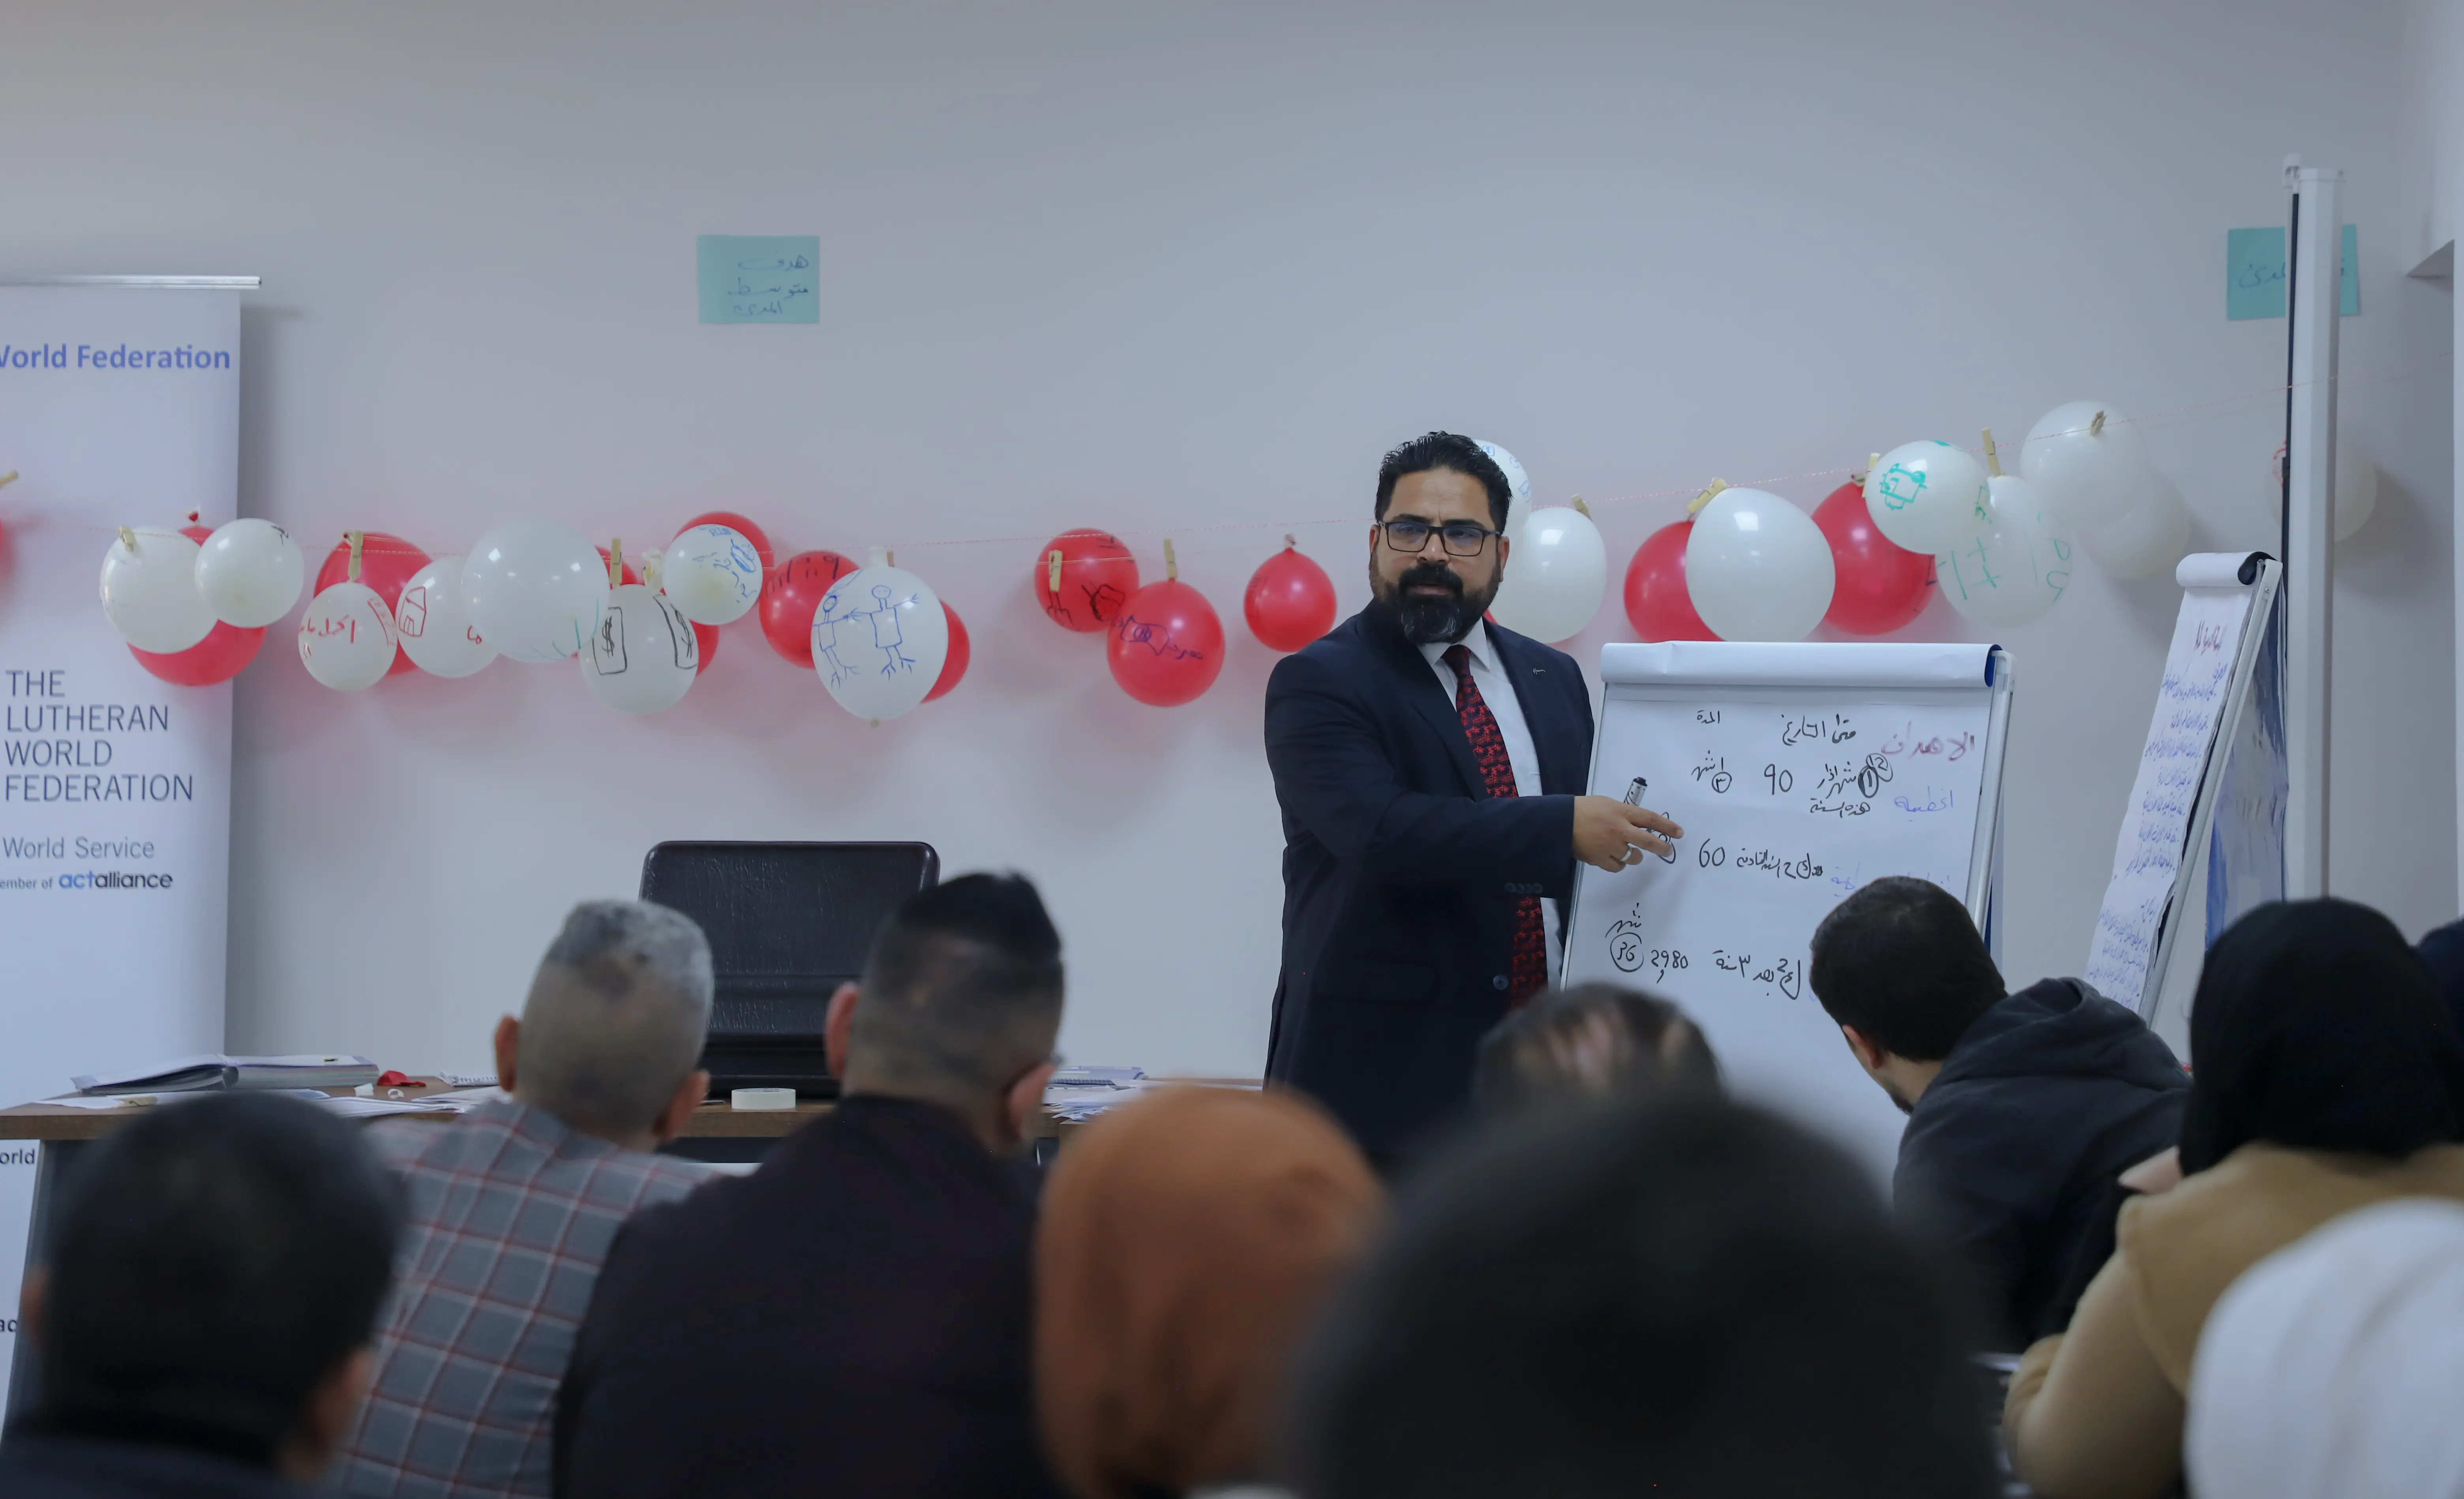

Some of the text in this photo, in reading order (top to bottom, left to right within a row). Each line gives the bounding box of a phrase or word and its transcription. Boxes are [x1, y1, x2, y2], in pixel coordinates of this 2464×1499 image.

[77, 344, 230, 369] Federation
[6, 670, 66, 698] THE
[7, 704, 169, 732] LUTHERAN
[4, 739, 113, 767] WORLD
[5, 774, 193, 803] FEDERATION
[1764, 764, 1793, 796] 90
[2, 836, 155, 859] World Service
[1699, 837, 1726, 868] 60
[0, 870, 173, 890] ember of actalliance
[0, 1149, 35, 1164] orld
